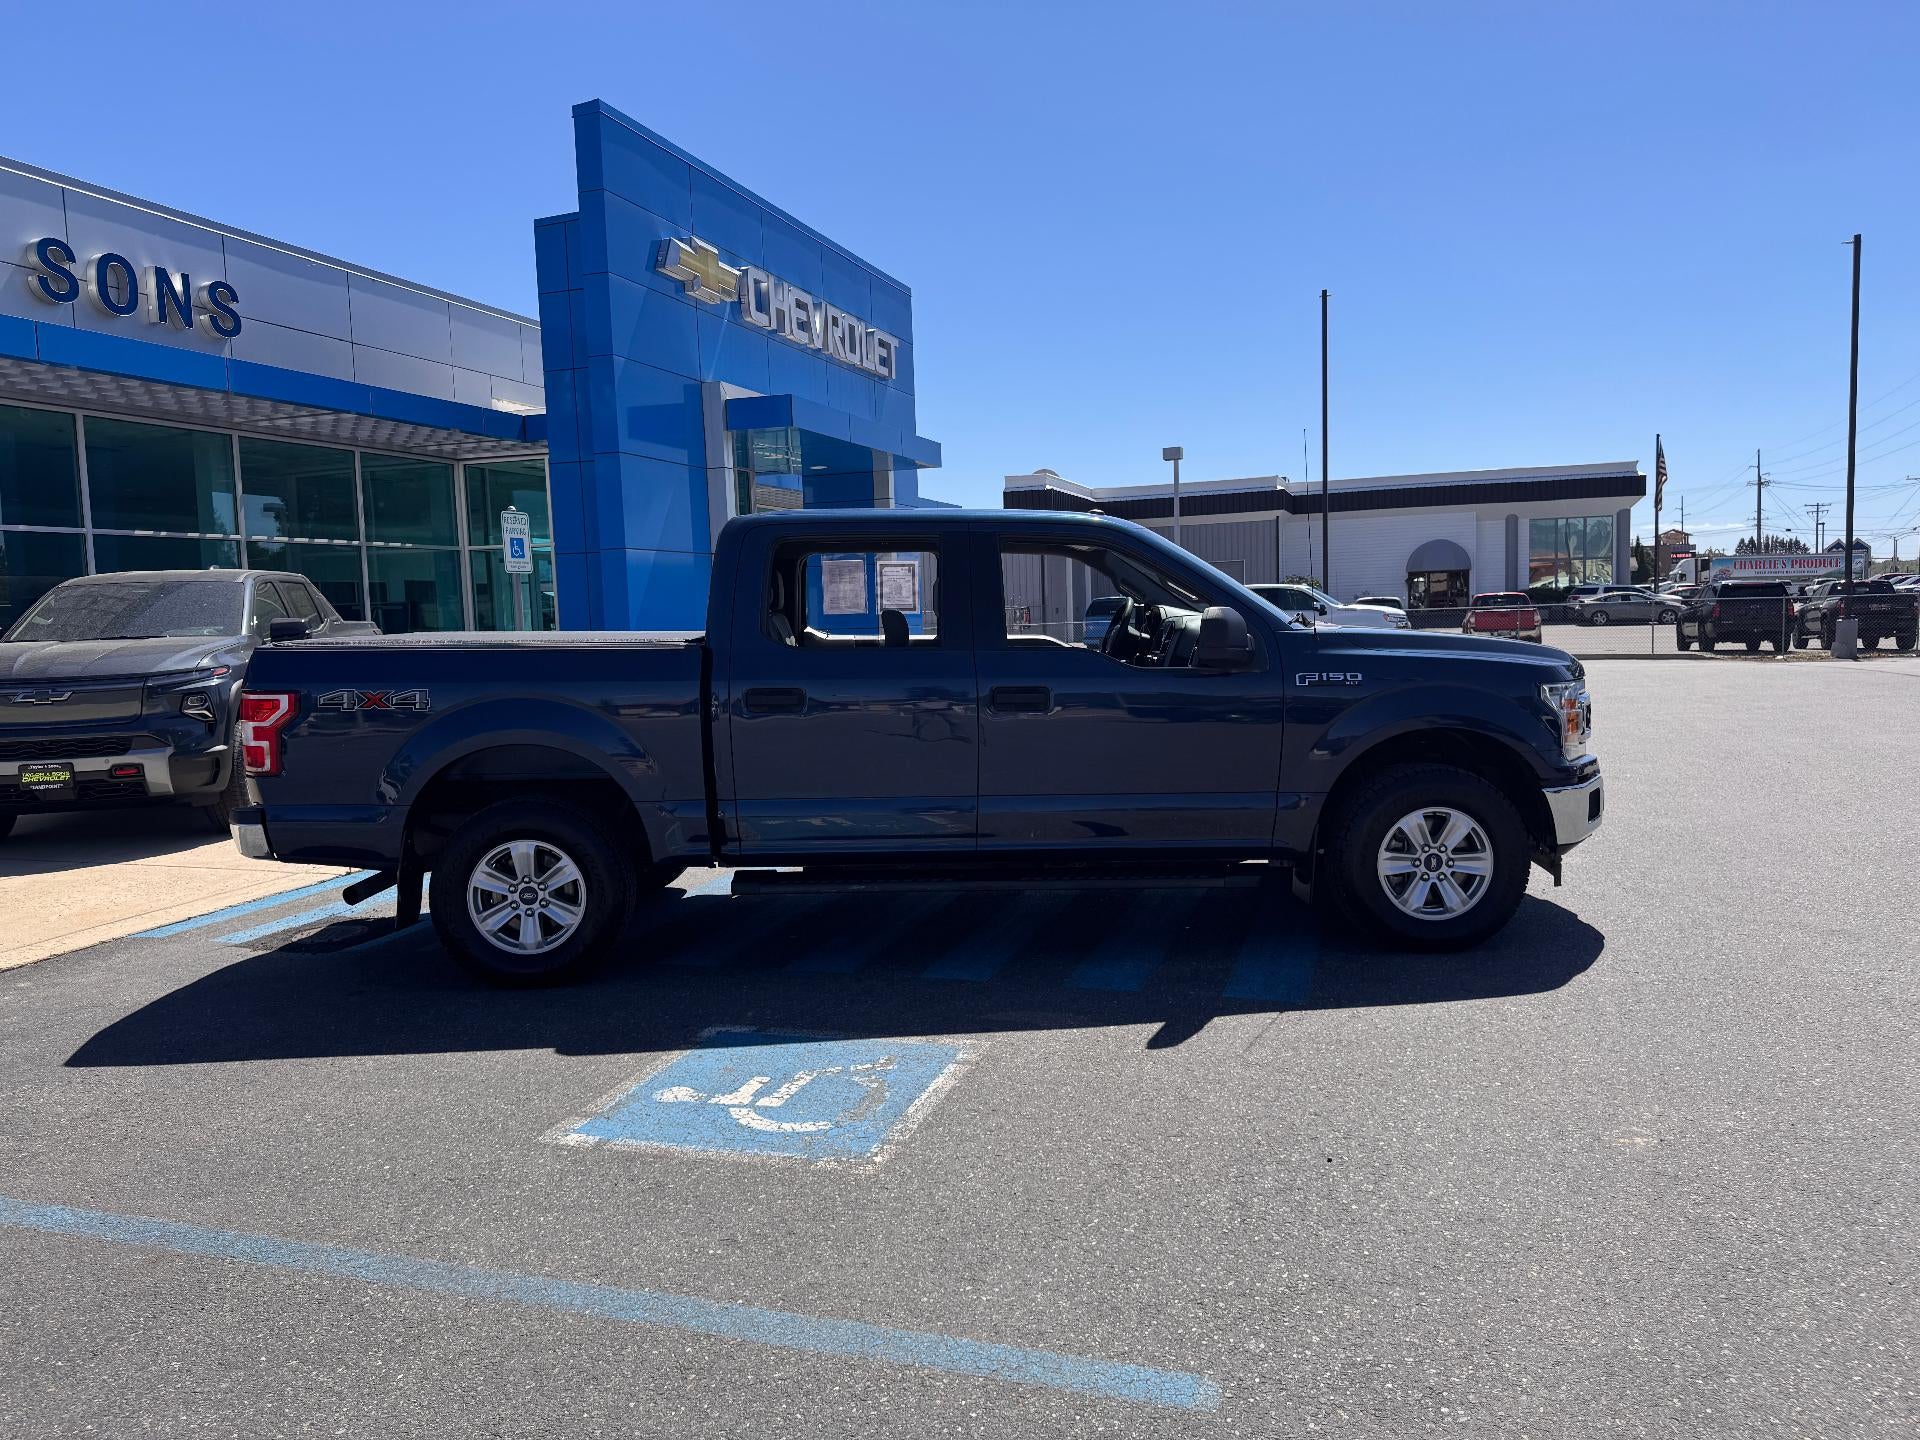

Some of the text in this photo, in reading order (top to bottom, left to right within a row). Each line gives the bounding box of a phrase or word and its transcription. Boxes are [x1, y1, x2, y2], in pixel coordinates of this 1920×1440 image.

[27, 237, 242, 338] SONS
[738, 266, 899, 379] CHEVROLET
[1733, 558, 1840, 570] CHARLIES PRODUCE
